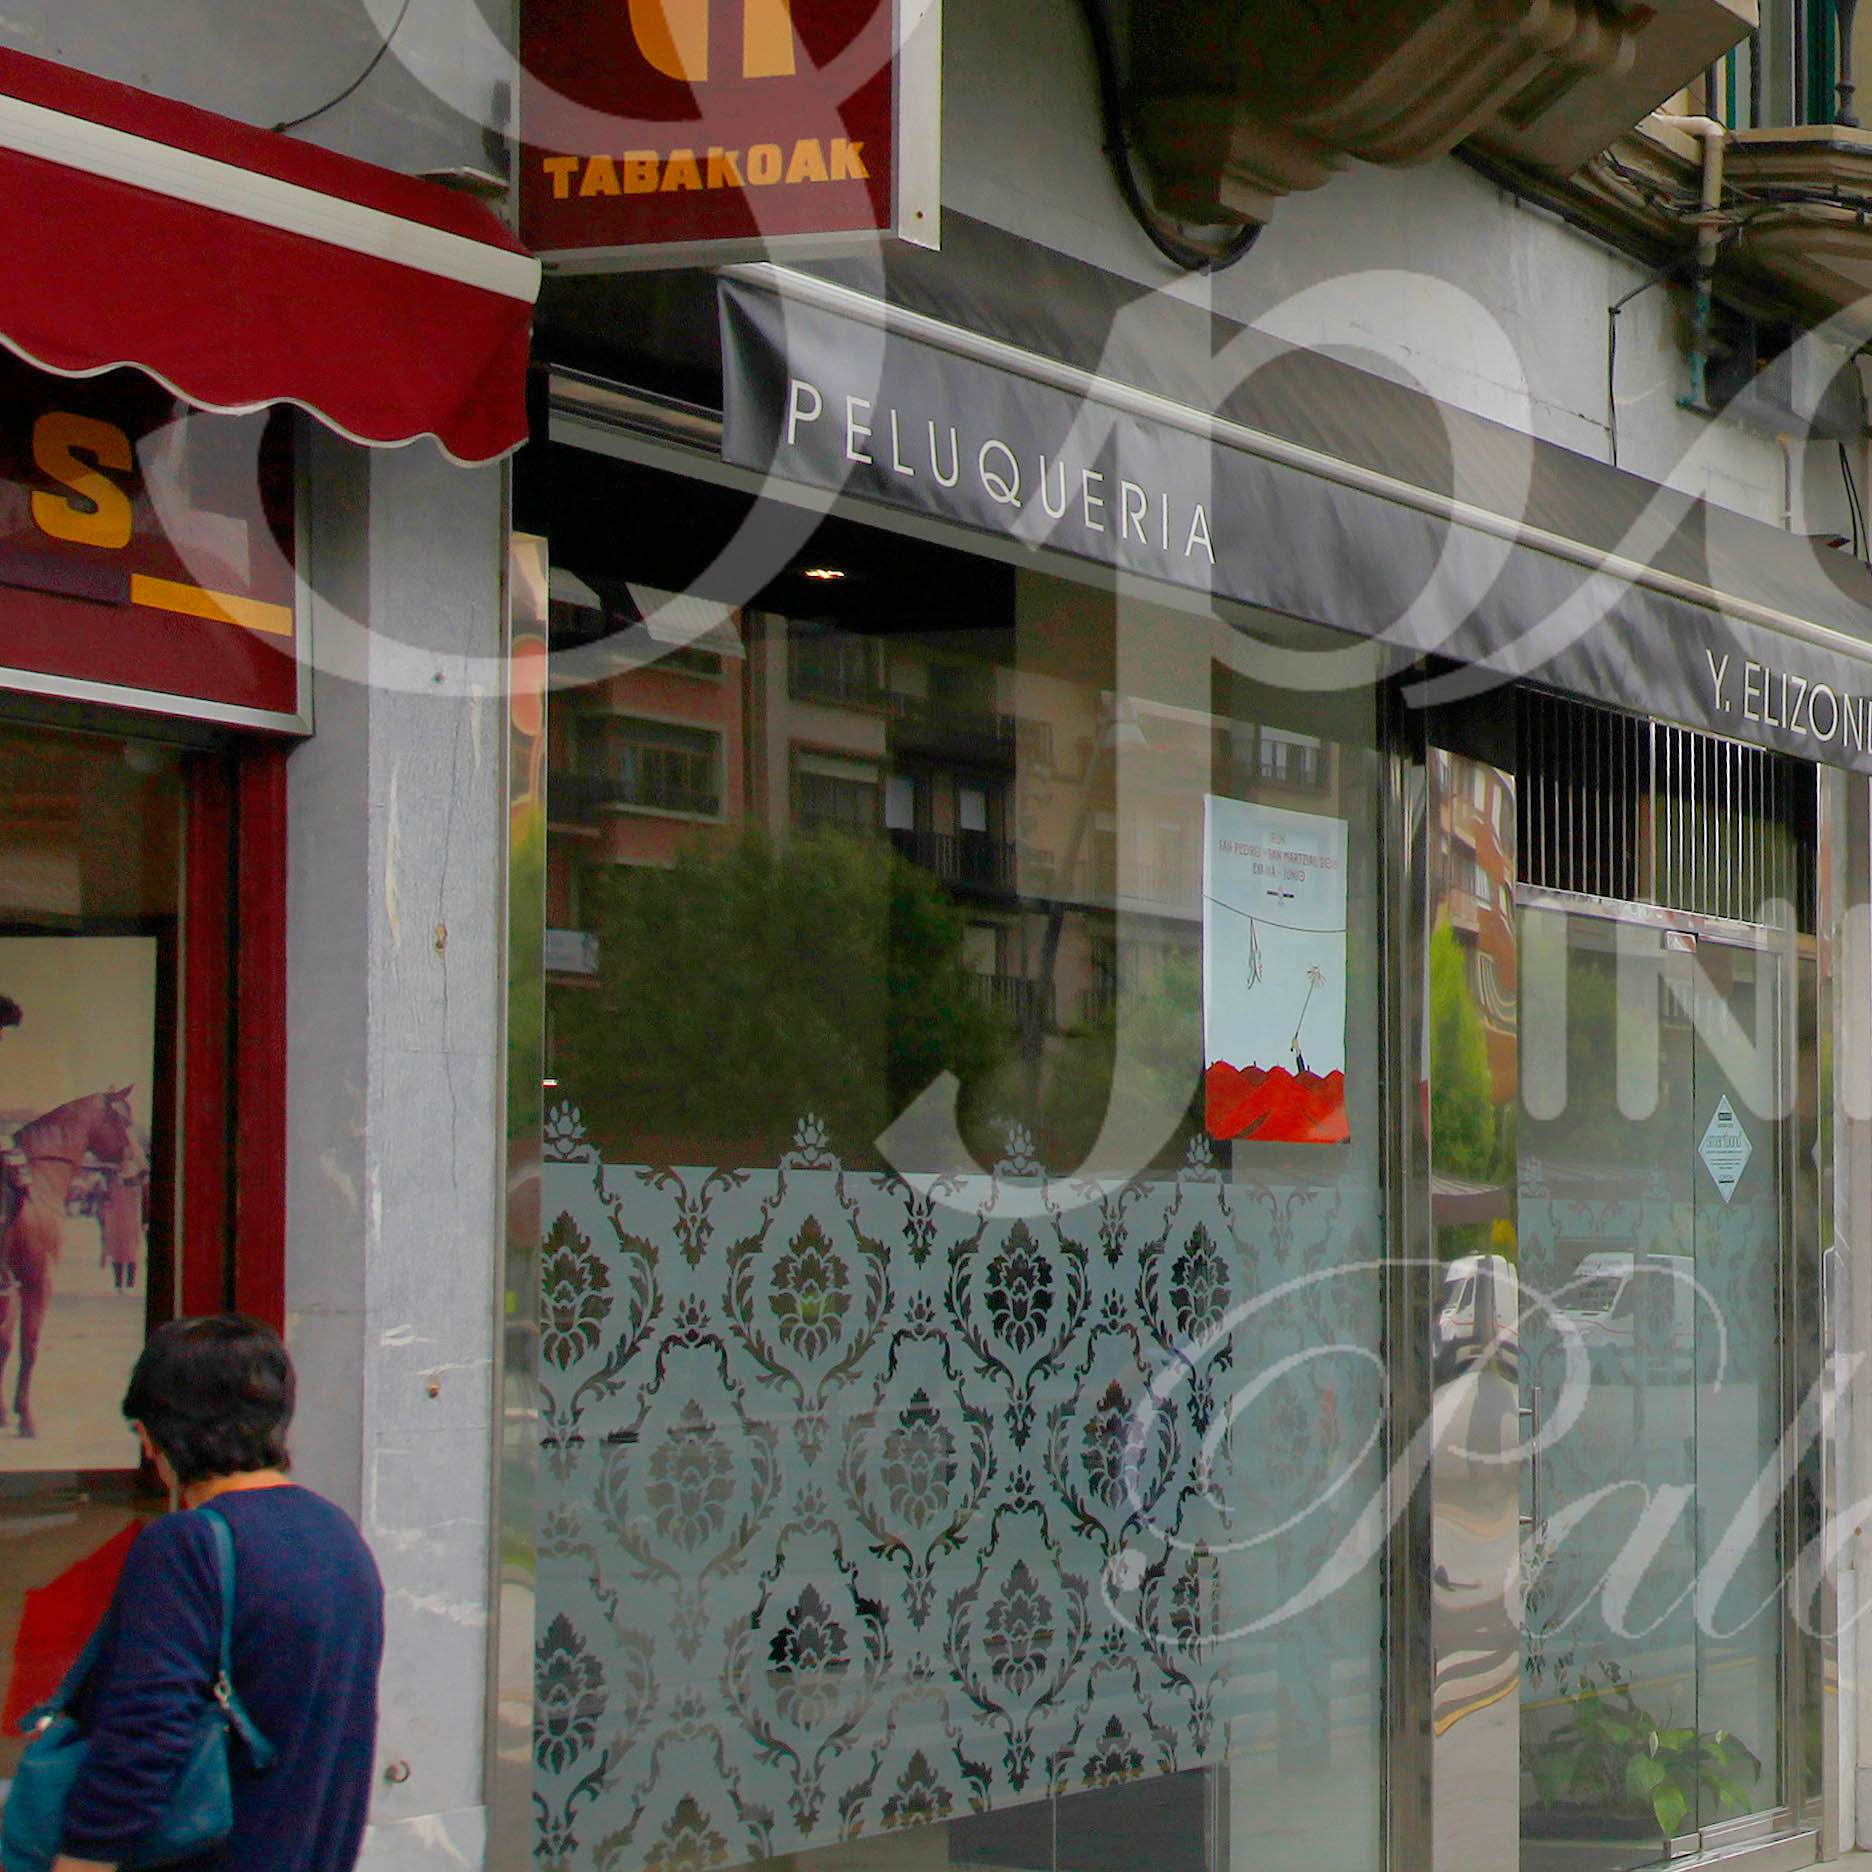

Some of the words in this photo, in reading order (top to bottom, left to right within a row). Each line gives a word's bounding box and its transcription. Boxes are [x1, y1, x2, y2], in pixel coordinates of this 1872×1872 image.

[543, 138, 870, 200] TABAKOAK
[786, 378, 1217, 565] PELUQUERIA
[1706, 648, 1731, 713] Y.
